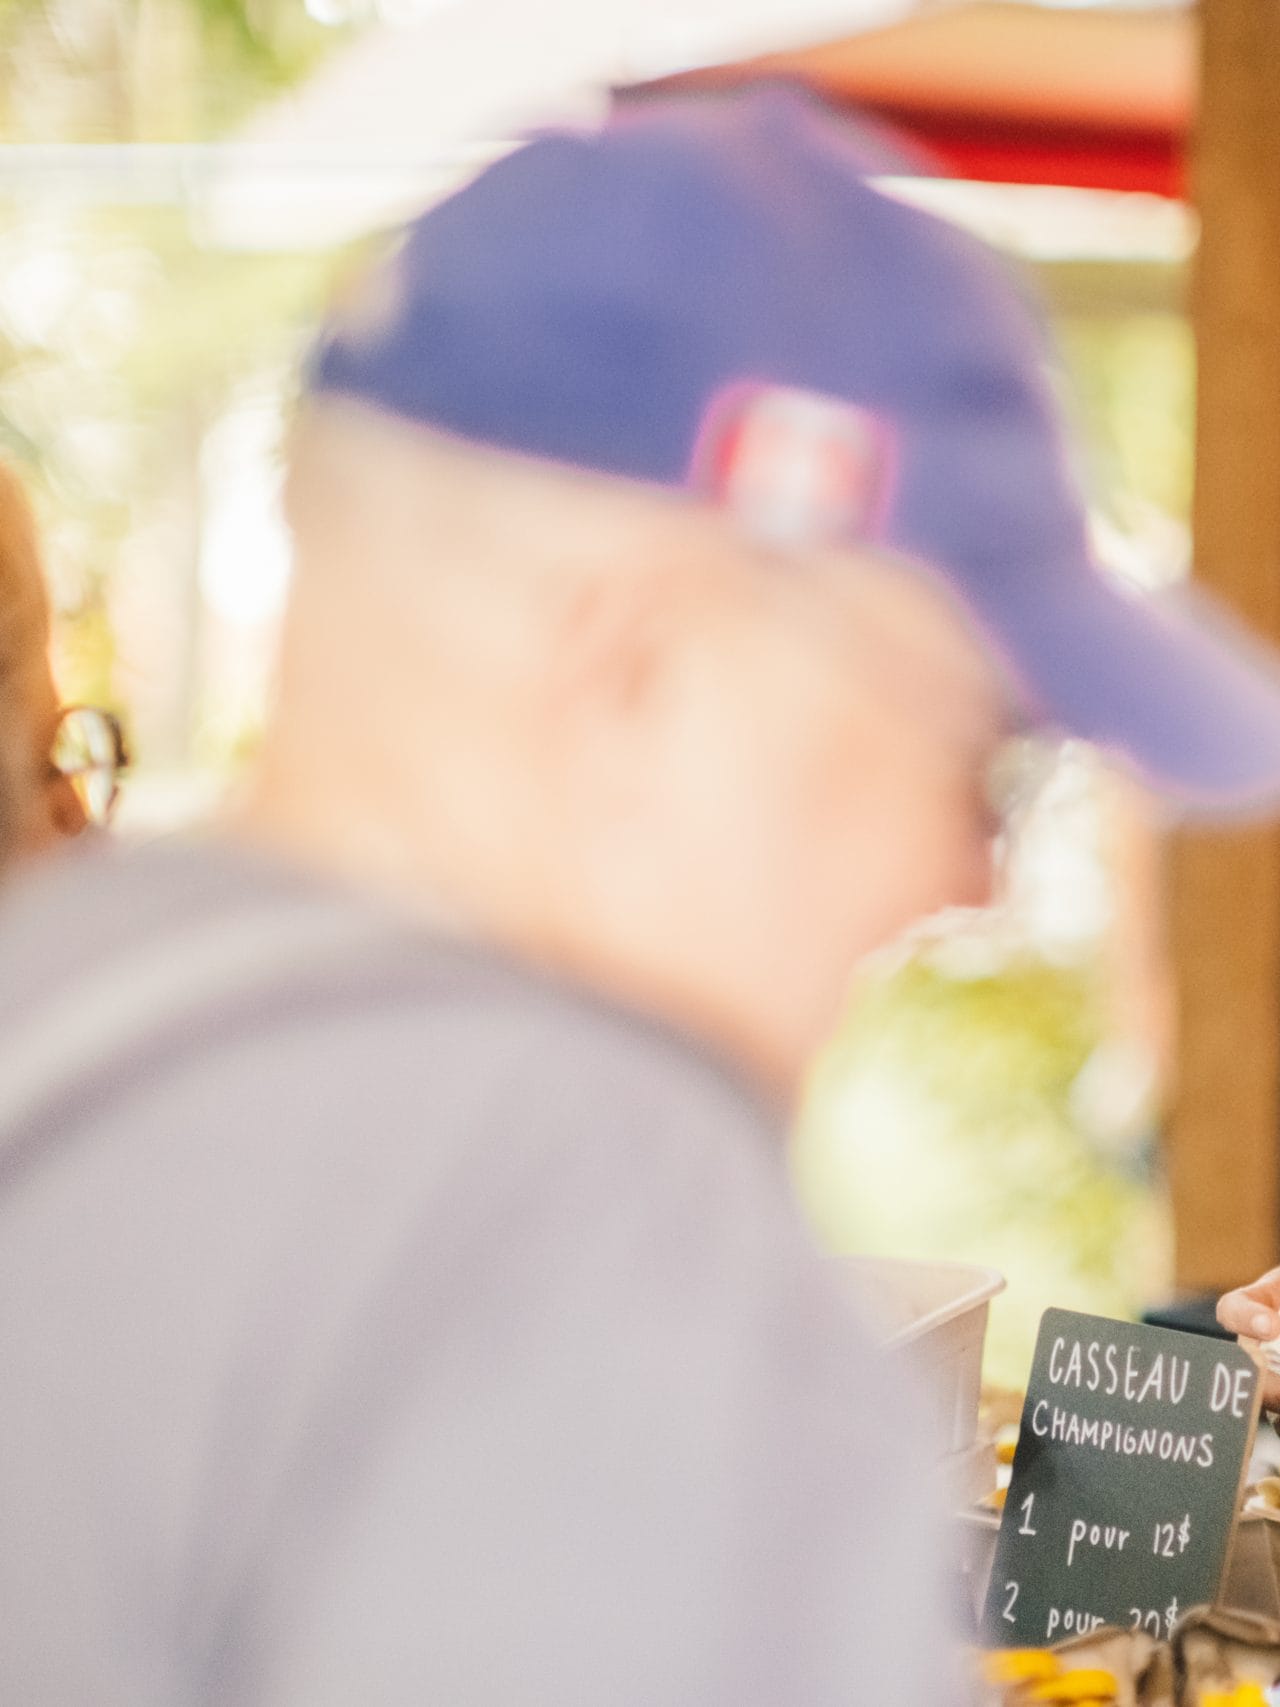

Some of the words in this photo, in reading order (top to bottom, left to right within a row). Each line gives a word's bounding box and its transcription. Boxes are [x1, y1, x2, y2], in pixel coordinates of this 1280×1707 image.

[1049, 1337, 1190, 1404] CASSEAU
[1210, 1362, 1253, 1418] DE
[1032, 1400, 1214, 1467] CHAMPIGNONS
[1018, 1493, 1037, 1536] 1
[1067, 1519, 1130, 1566] pour
[1153, 1513, 1191, 1557] 12$
[1002, 1581, 1020, 1623] 2
[1047, 1608, 1105, 1638] pour
